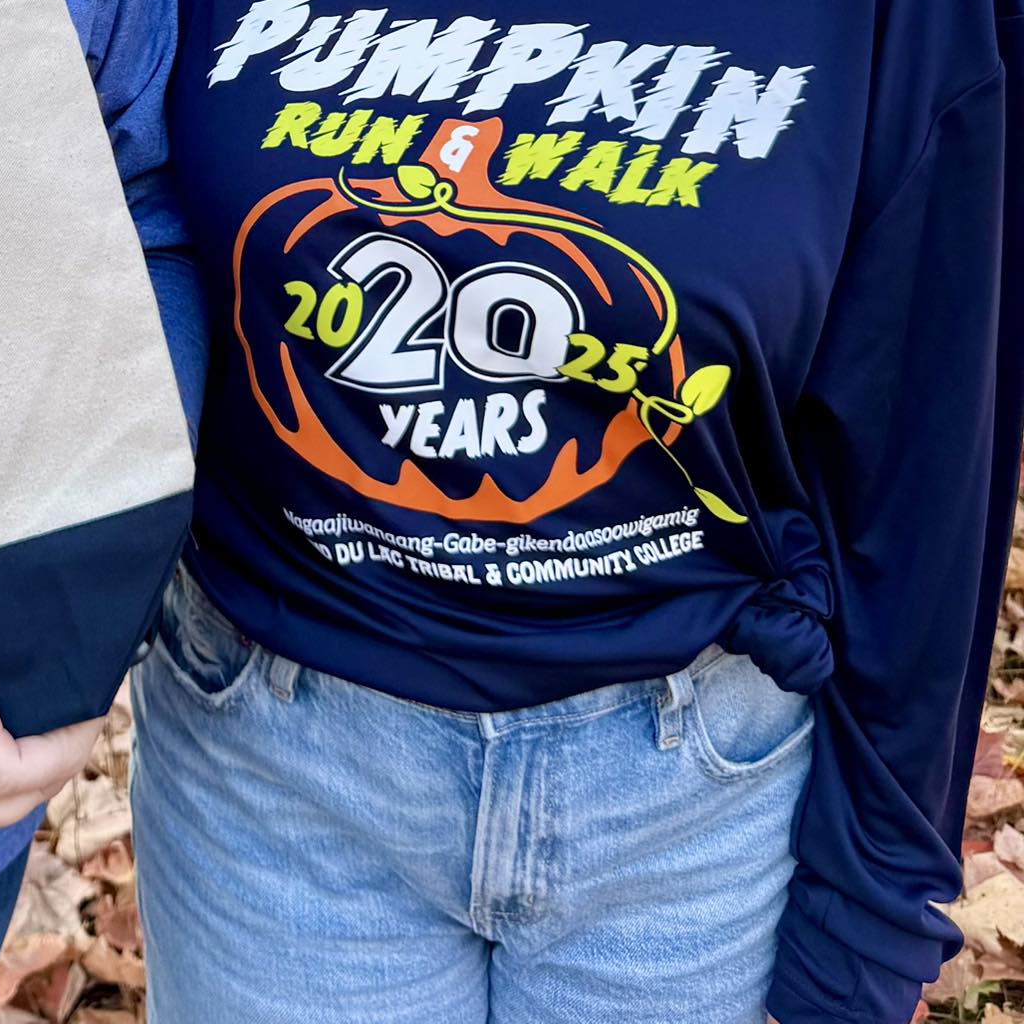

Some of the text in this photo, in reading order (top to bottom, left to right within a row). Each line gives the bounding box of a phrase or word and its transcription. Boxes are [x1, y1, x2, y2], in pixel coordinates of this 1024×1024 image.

[261, 102, 719, 208] RUN & WALK
[283, 280, 364, 349] 20
[324, 231, 586, 394] 20
[555, 333, 649, 394] 25
[378, 388, 548, 459] YEARS
[335, 540, 365, 567] DU
[367, 541, 404, 569] LAC
[404, 554, 483, 586] TRIBAL
[484, 562, 504, 587] &
[506, 548, 638, 586] COMMUNITY
[633, 530, 705, 567] COLLEGE
